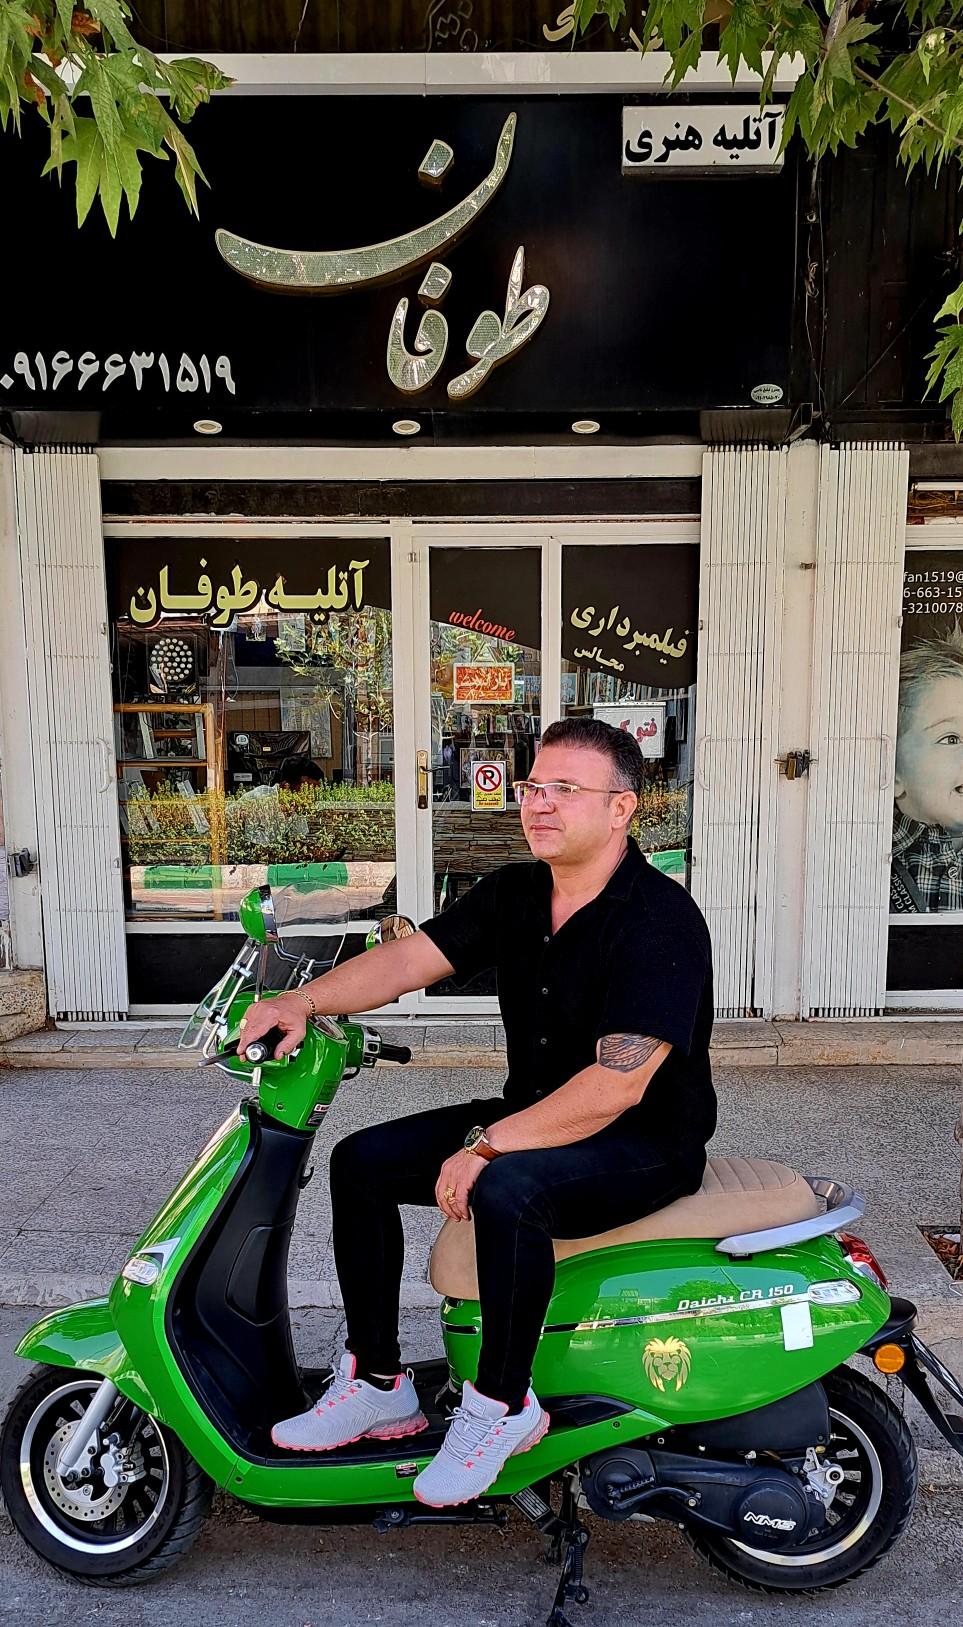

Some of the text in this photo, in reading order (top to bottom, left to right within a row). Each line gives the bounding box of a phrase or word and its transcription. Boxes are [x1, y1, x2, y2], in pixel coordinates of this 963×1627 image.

[624, 111, 783, 163] آتلیه هنری
[213, 111, 550, 399] طوفان
[0, 350, 236, 395] ۰۹۱۶۶۶۳۱۵۱۹
[129, 558, 370, 625] آتلیه طوفان
[448, 608, 517, 641] welcome
[570, 605, 690, 665] فیلمبرداری
[573, 646, 625, 672] مجالس
[677, 1284, 794, 1311] Daichi CR 150
[743, 1511, 797, 1531] NMS
